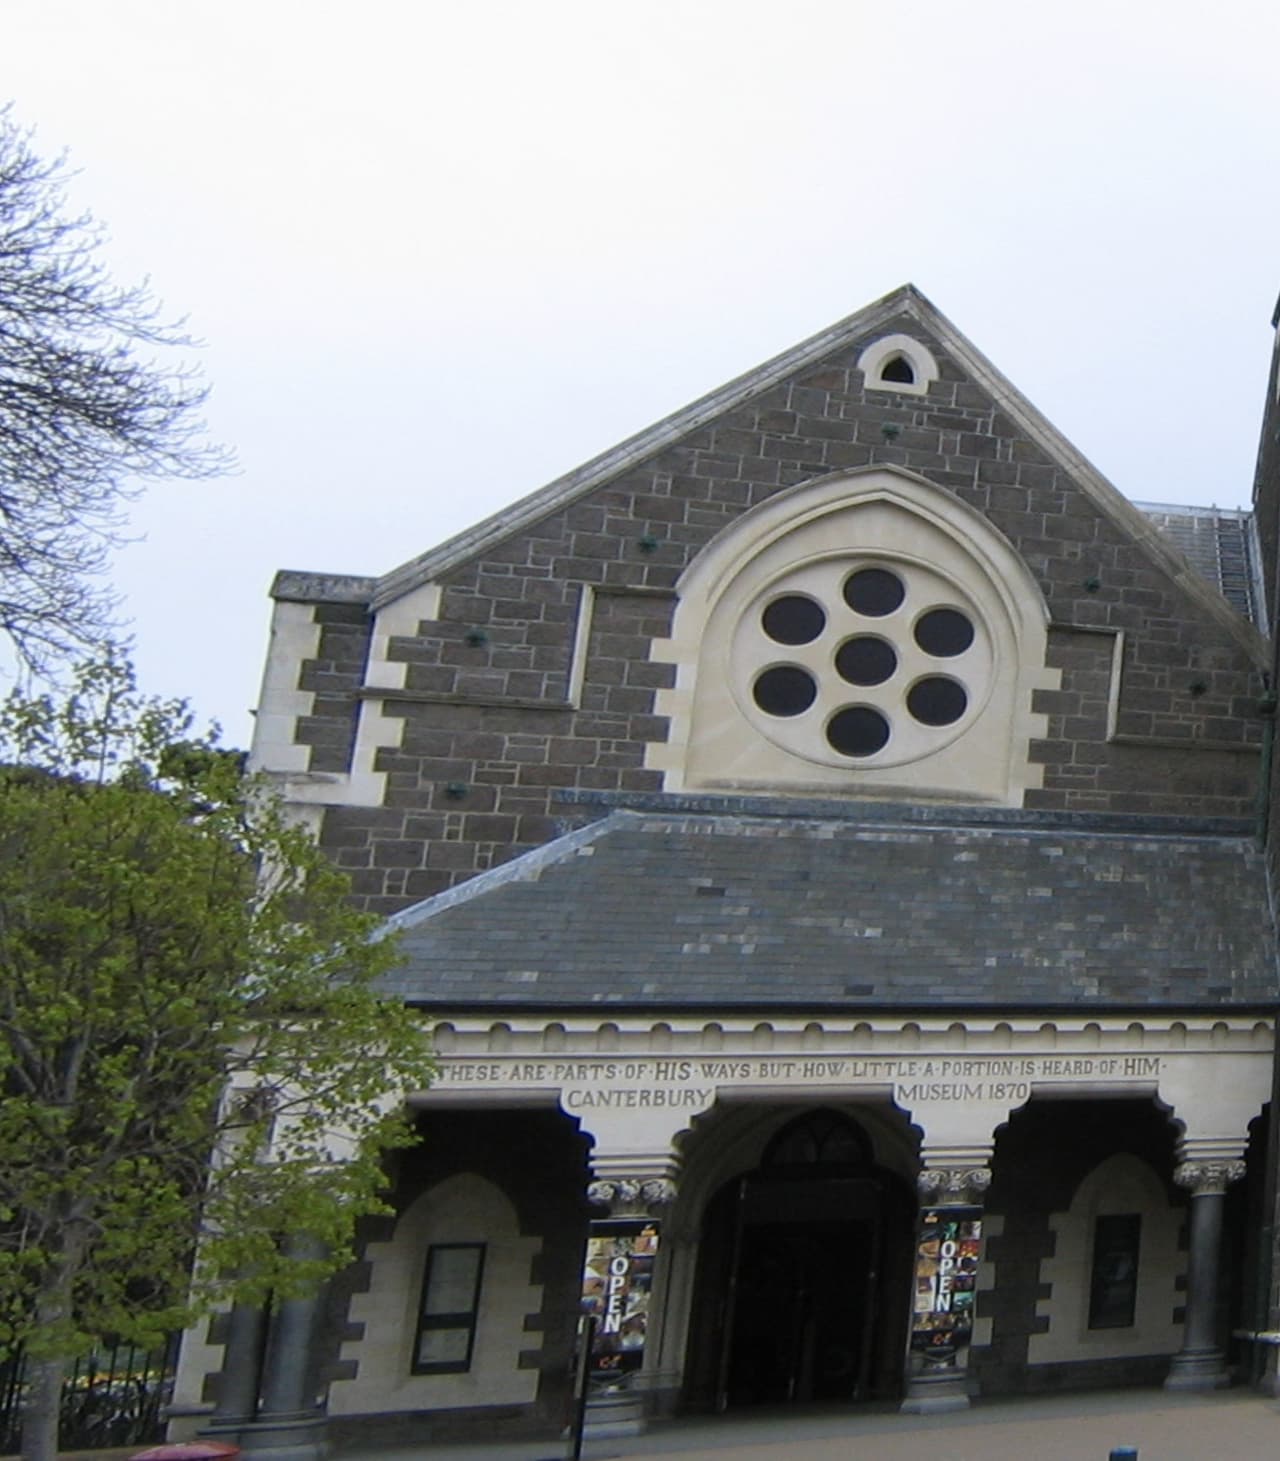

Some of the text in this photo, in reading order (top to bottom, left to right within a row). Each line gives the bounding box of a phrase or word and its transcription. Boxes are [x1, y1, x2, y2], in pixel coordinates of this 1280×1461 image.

[438, 1058, 1161, 1081] THESE ARE PARTS OF HIS WAYS BUT HOW LITTLE A PORTION IS HEARD OF HIM
[568, 1088, 712, 1108] CANTERBURY
[898, 1083, 1028, 1101] MUSEUM 1870
[936, 1240, 957, 1313] OPEN
[604, 1256, 629, 1334] OPEN
